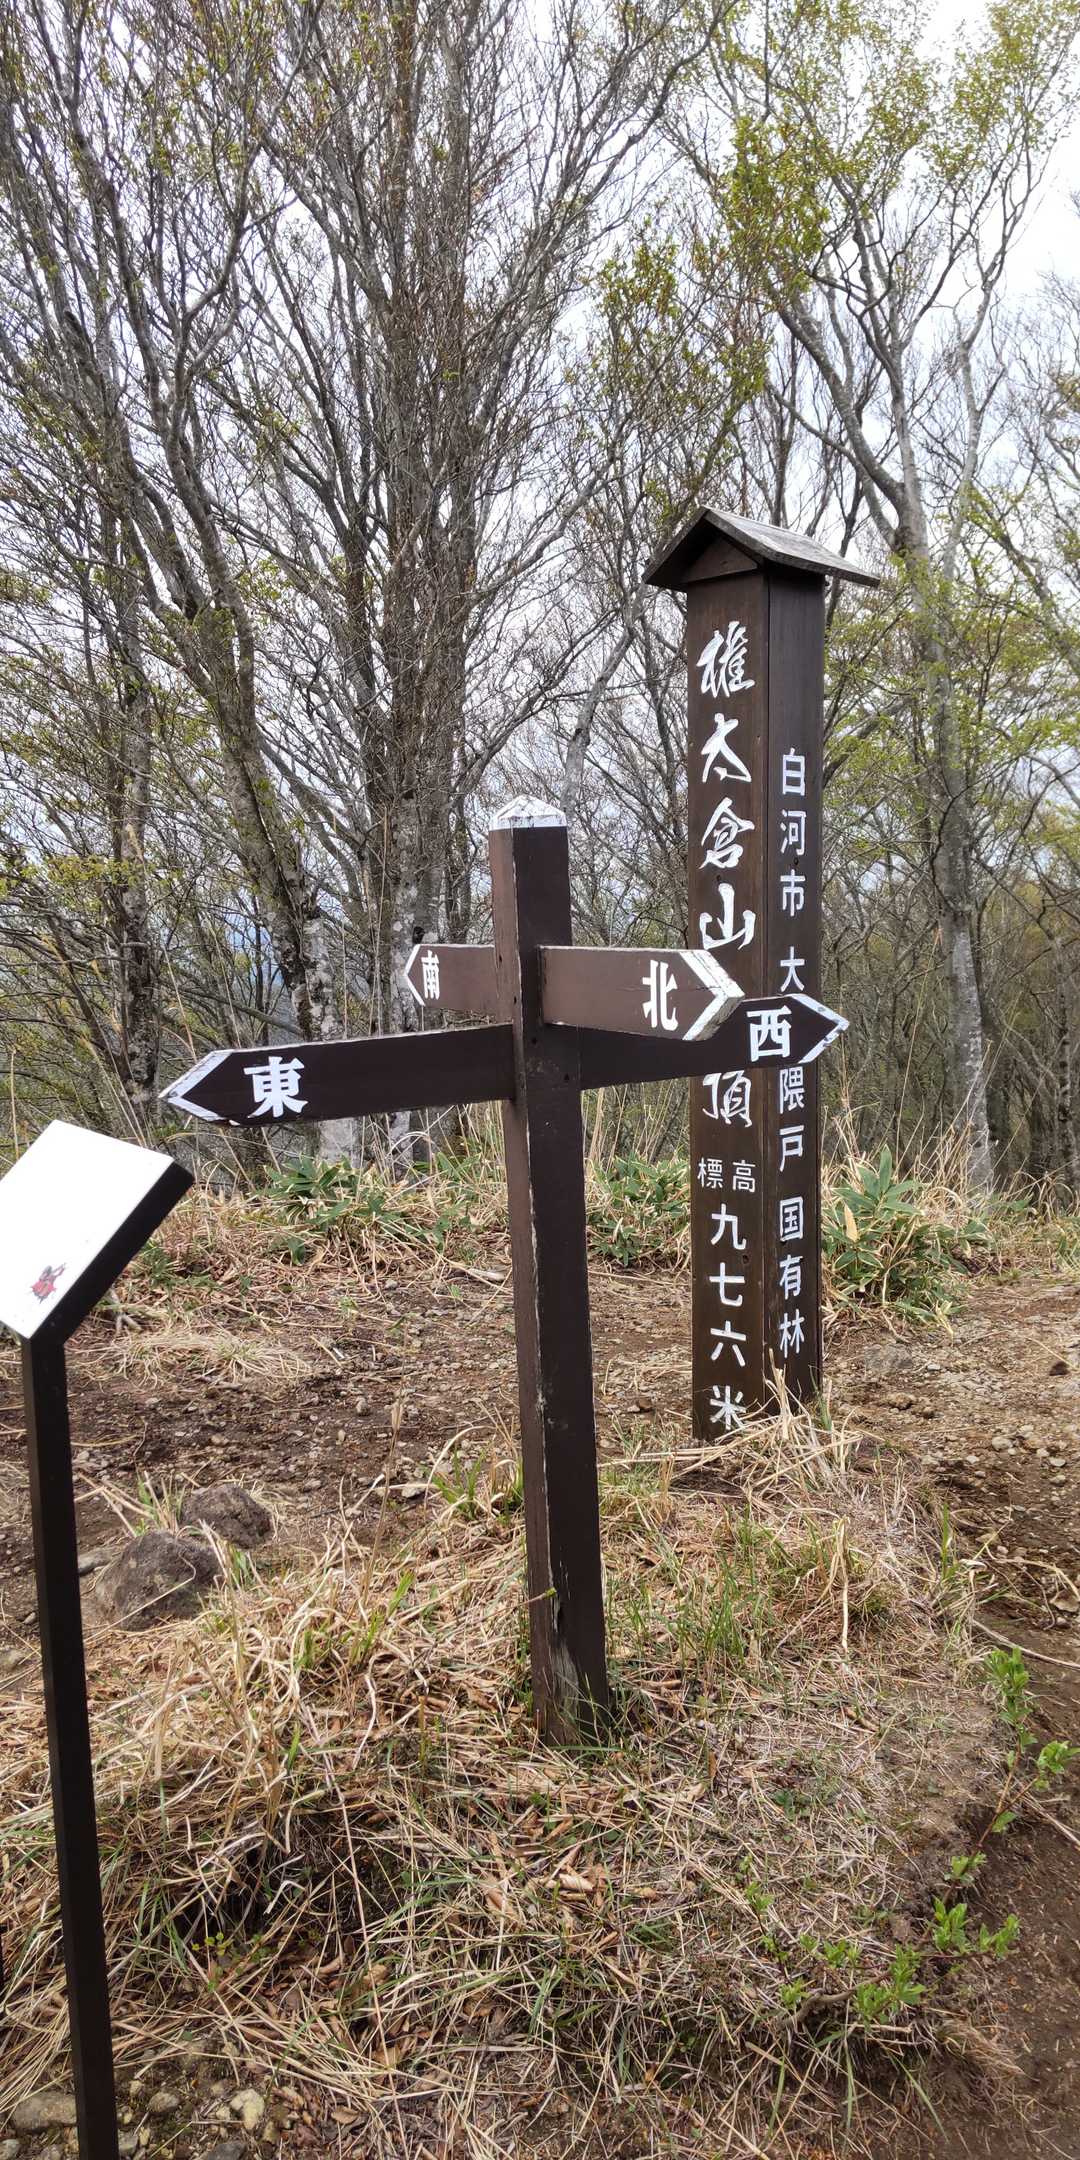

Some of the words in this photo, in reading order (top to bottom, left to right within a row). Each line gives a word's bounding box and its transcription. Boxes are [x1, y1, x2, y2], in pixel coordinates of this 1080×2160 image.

[421, 951, 441, 1000] 南
[642, 959, 678, 1032] 北
[746, 1005, 792, 1062] 西
[243, 1056, 308, 1119] 東
[708, 1203, 748, 1432] 九七六米
